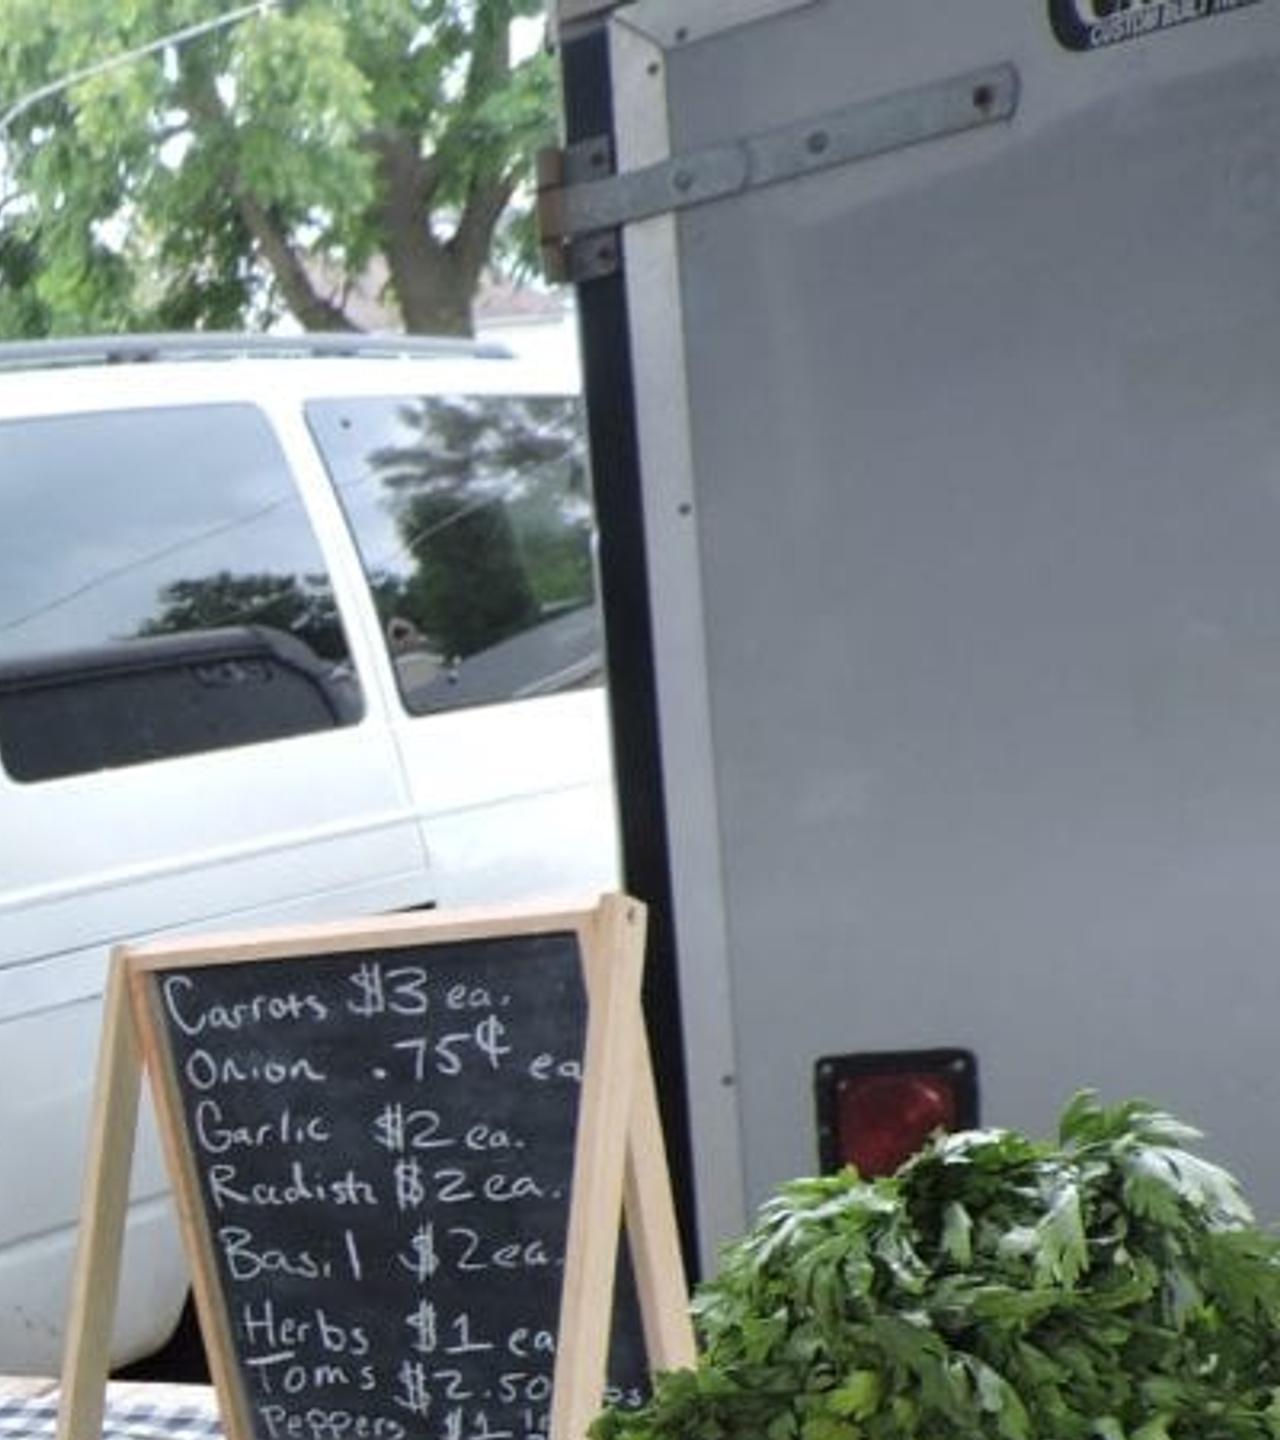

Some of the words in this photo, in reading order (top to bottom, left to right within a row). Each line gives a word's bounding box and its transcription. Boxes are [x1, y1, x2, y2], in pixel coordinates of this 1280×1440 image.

[163, 975, 328, 1034] Carrots
[346, 962, 429, 1016] $3
[186, 1049, 326, 1089] Onion
[195, 1100, 331, 1153] Garlic
[373, 1102, 455, 1151] $2
[465, 1124, 525, 1150] ea.
[208, 1161, 379, 1208] Radish
[393, 1156, 476, 1210] $2
[483, 1176, 562, 1200] ea.
[218, 1226, 361, 1281] Basil
[244, 1300, 370, 1356] Herbs
[405, 1299, 494, 1353] $1
[245, 1351, 377, 1394] Toms
[393, 1360, 551, 1414] $2.50
